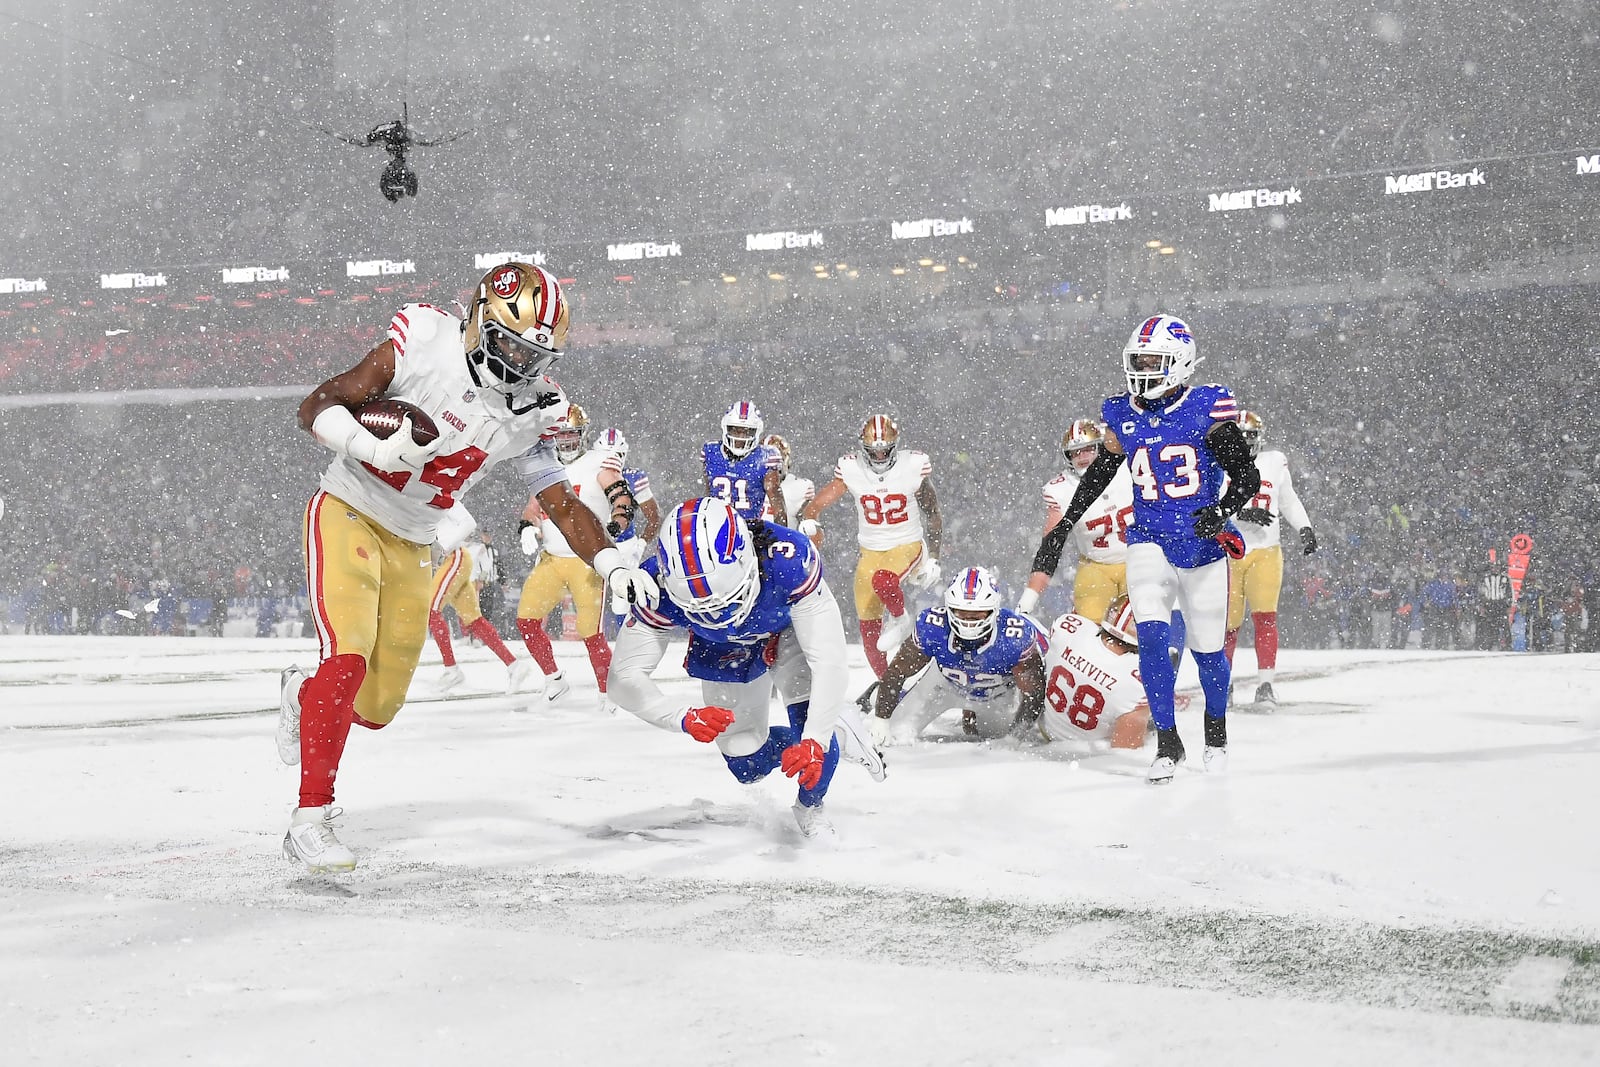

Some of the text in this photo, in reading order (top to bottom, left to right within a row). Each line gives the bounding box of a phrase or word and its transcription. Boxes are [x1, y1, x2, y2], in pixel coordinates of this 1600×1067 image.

[1385, 168, 1486, 195] M&T Bank
[1208, 186, 1302, 212] M&T Bank
[1090, 202, 1132, 223] Bank
[933, 216, 974, 237] Bank
[645, 241, 682, 258] Bank
[785, 230, 823, 248] Bank
[382, 259, 416, 275] Bank
[511, 251, 546, 265] Bank
[135, 272, 167, 288] Bank
[257, 266, 290, 282] Bank
[441, 410, 467, 433] 49ERS
[361, 445, 489, 510] 4
[1131, 444, 1201, 502] 43
[712, 476, 751, 510] 31
[859, 493, 908, 525] 82
[768, 540, 797, 560] 3
[1005, 617, 1025, 638] 92
[1061, 645, 1118, 692] McKIVITZ
[1046, 664, 1106, 731] 68
